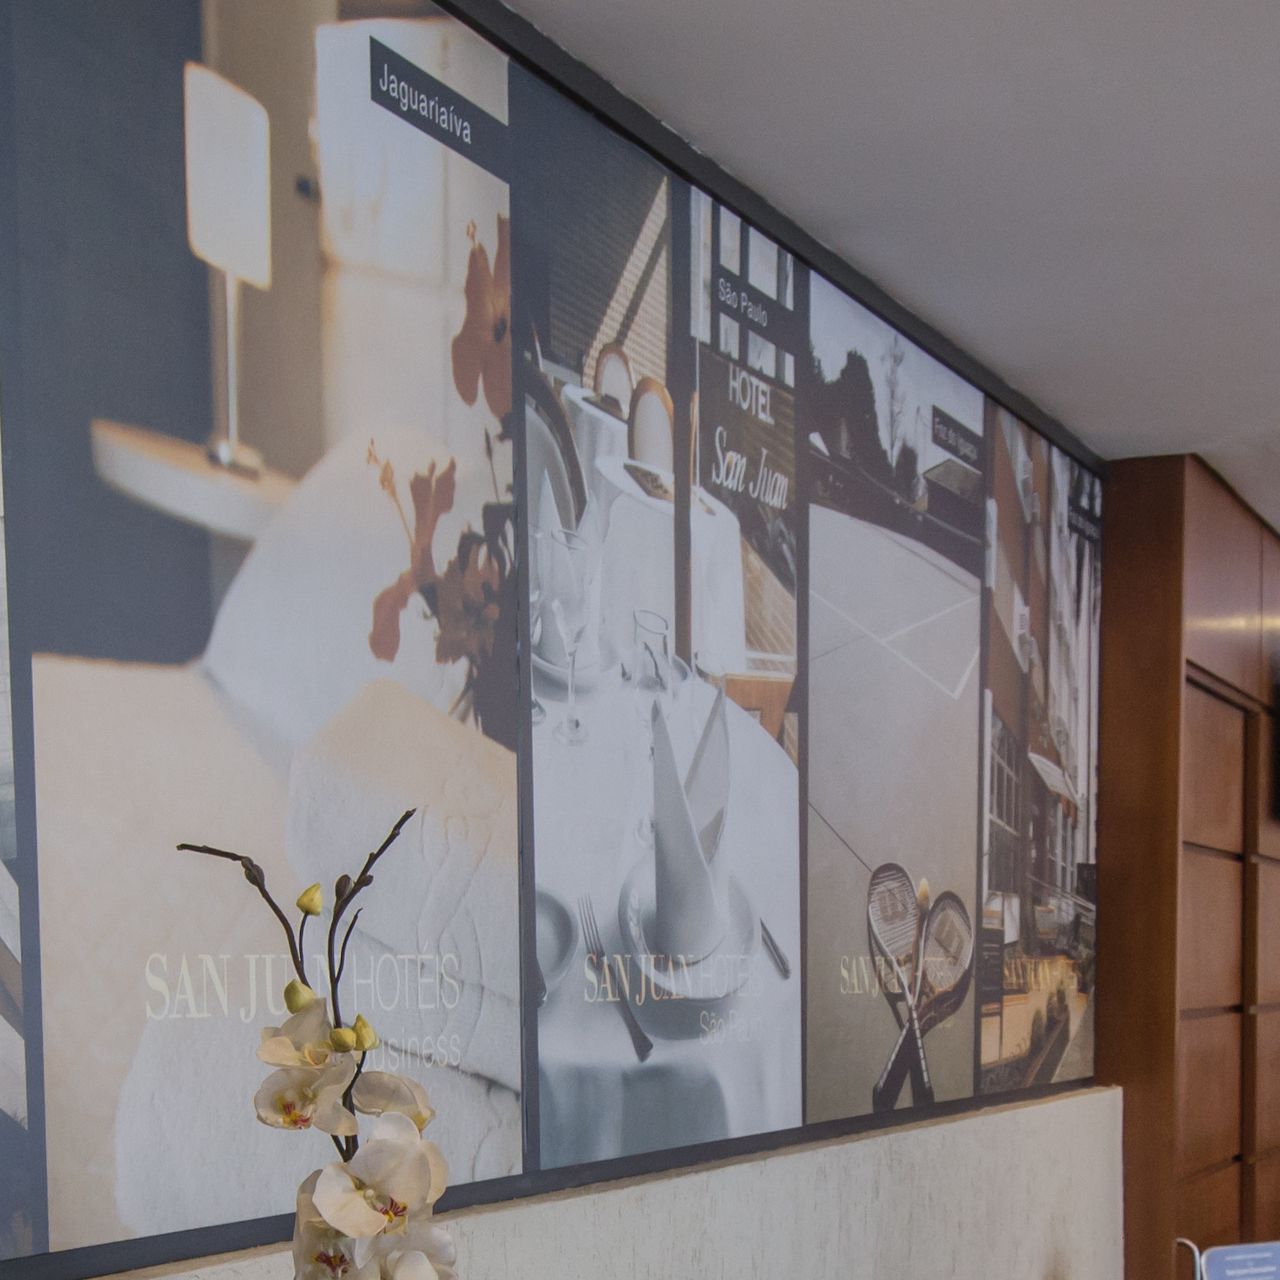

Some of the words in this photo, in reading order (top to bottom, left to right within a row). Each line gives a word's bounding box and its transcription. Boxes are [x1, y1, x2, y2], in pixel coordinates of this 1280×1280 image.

[378, 63, 472, 145] Jaguariaíva
[718, 277, 739, 309] São
[740, 291, 768, 328] Paulo
[729, 362, 776, 426] HOTEL
[711, 425, 747, 493] San
[748, 447, 789, 511] Juan
[143, 951, 231, 1020] SAN
[239, 952, 331, 1024] JUN
[353, 940, 462, 1012] HOTÉIS
[583, 953, 634, 1003] SAN
[635, 953, 698, 1007] JUAN
[368, 1026, 462, 1072] usiness
[699, 1010, 726, 1046] São
